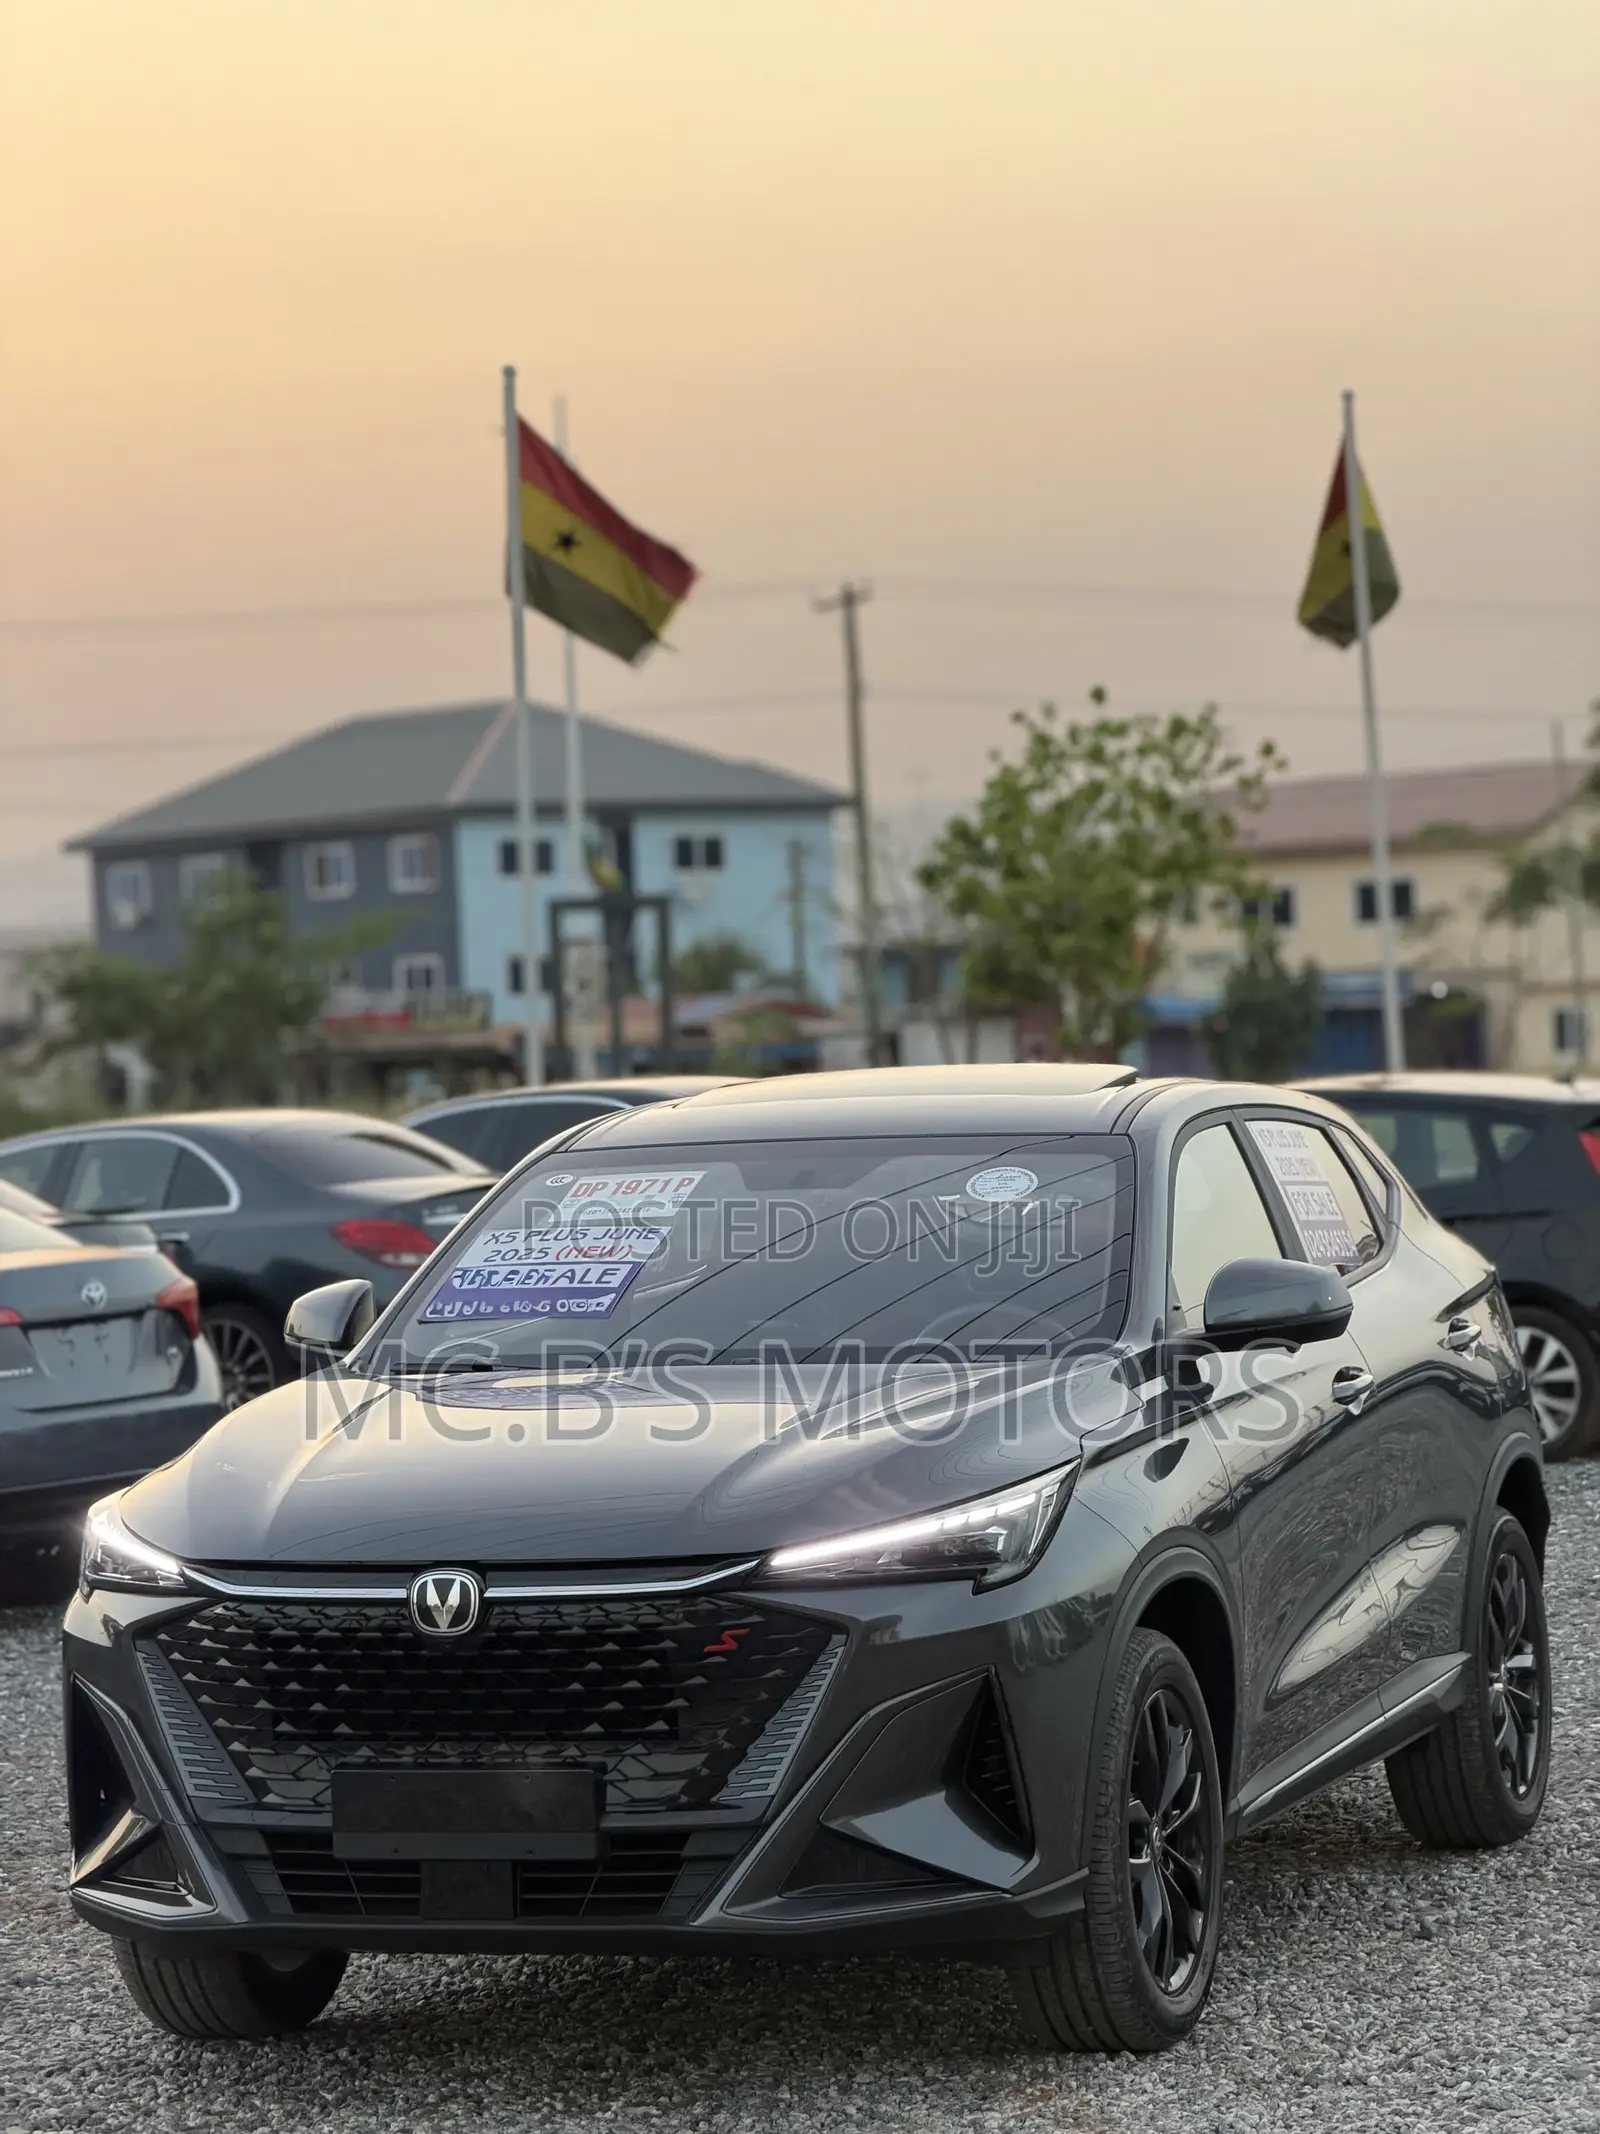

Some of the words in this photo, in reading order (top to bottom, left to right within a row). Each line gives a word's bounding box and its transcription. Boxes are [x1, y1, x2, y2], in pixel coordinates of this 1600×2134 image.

[570, 1181, 609, 1198] DP
[611, 1178, 674, 1196] 1971
[672, 1177, 696, 1193] P
[484, 1231, 518, 1246] X5
[522, 1228, 590, 1243] PLUS
[592, 1227, 662, 1241] JUNE
[483, 1247, 550, 1262] 2025
[555, 1244, 633, 1261] (NEW)
